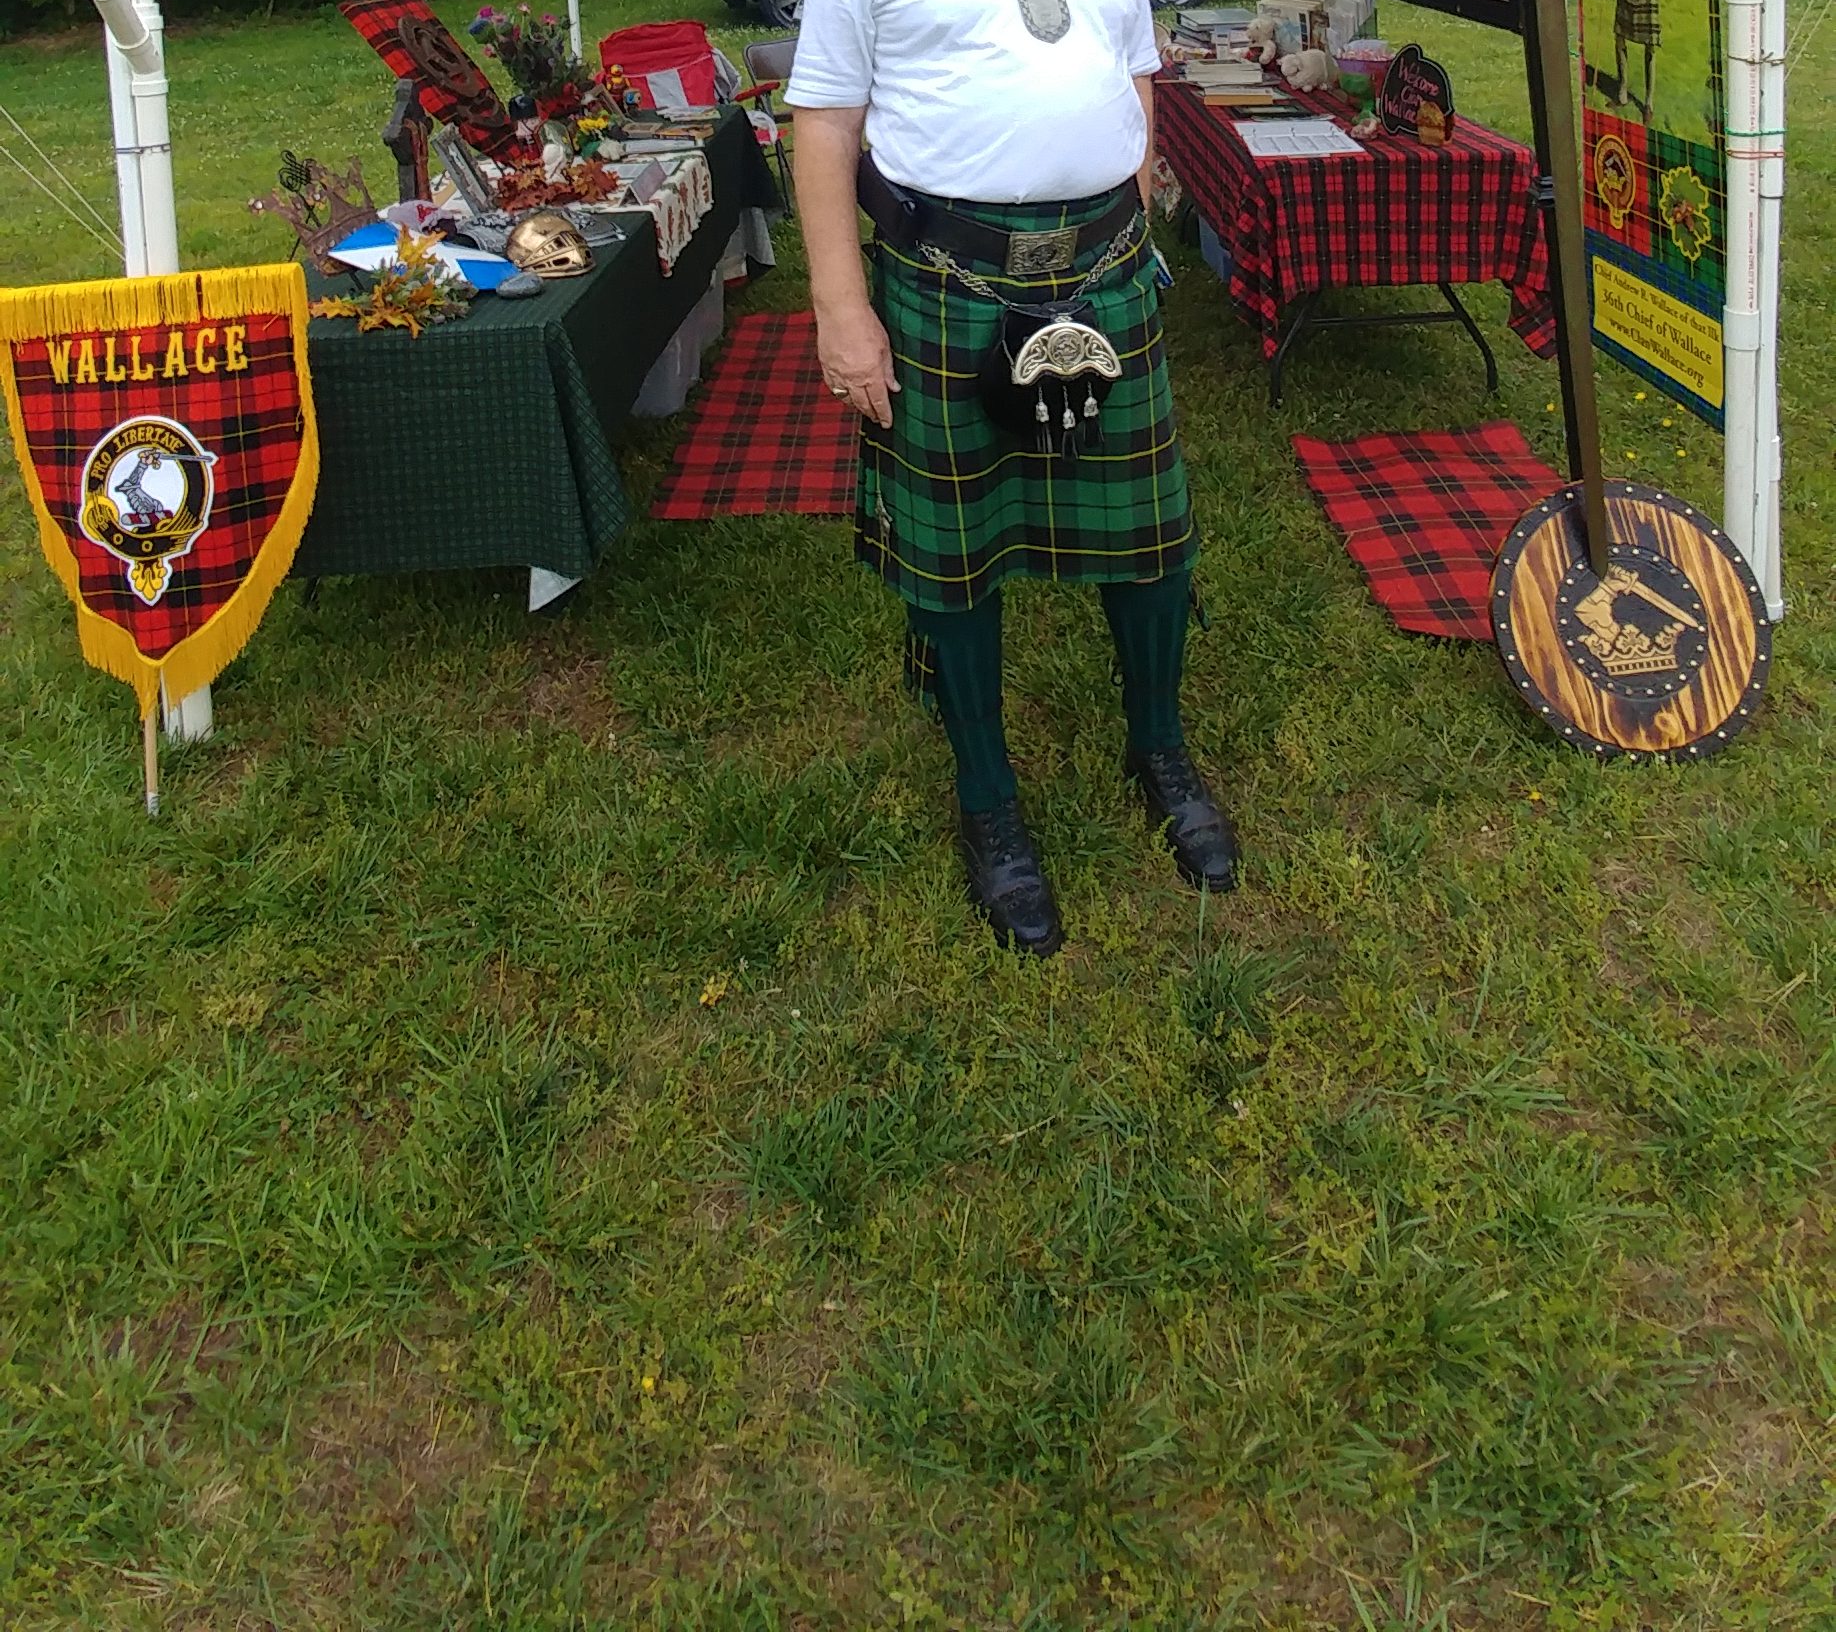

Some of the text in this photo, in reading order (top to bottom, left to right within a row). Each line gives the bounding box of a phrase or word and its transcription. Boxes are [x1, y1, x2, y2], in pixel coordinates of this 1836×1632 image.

[1602, 288, 1712, 365] 36th Chief of Wallace
[1679, 311, 1689, 324] of
[46, 325, 249, 385] WALLACE
[90, 425, 185, 480] PRO LIBERTATE
